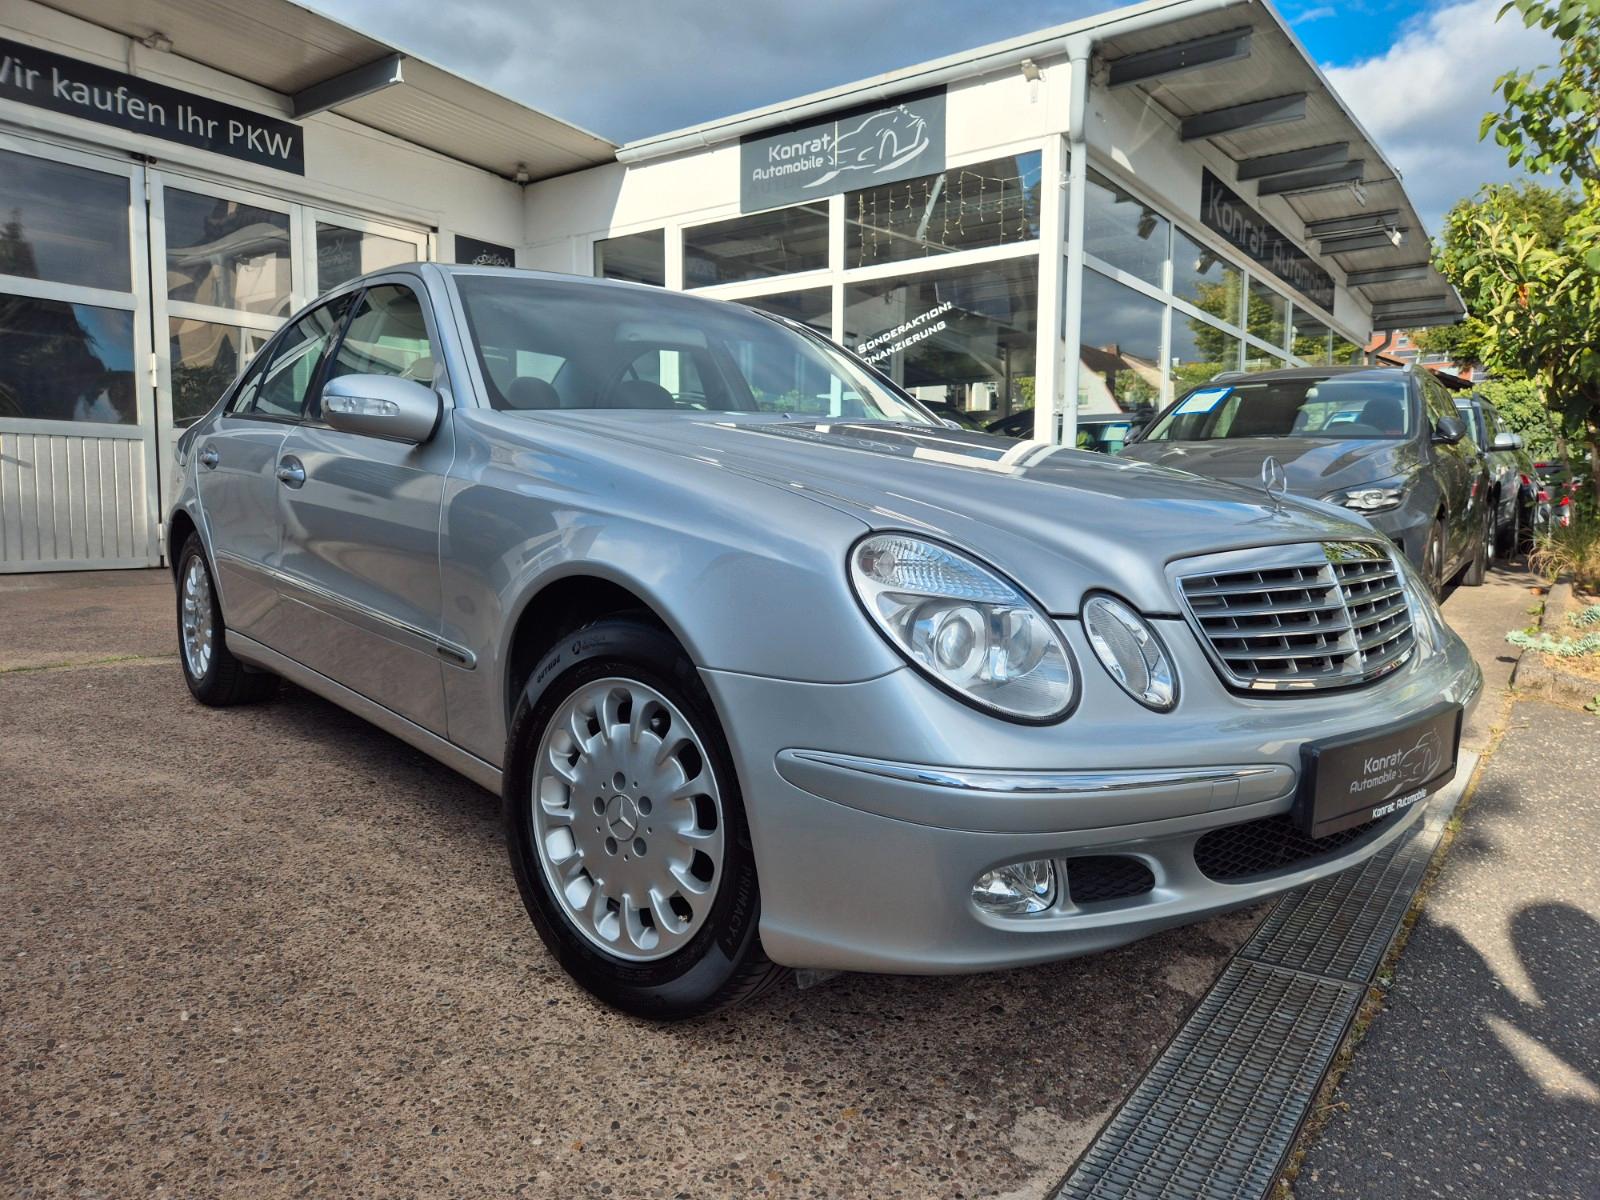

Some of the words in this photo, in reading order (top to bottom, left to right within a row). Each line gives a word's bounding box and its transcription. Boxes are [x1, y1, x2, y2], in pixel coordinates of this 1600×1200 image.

[52, 67, 165, 126] kaufen
[177, 104, 219, 139] Ihr
[228, 120, 293, 159] PKW
[768, 133, 831, 163] Konrat
[752, 155, 824, 181] Automobile
[1208, 180, 1268, 258] Konrat
[1363, 748, 1402, 775] Konrat
[1349, 768, 1397, 794] Automobile
[1372, 802, 1396, 818] Konrat
[1396, 788, 1427, 809] Automobile
